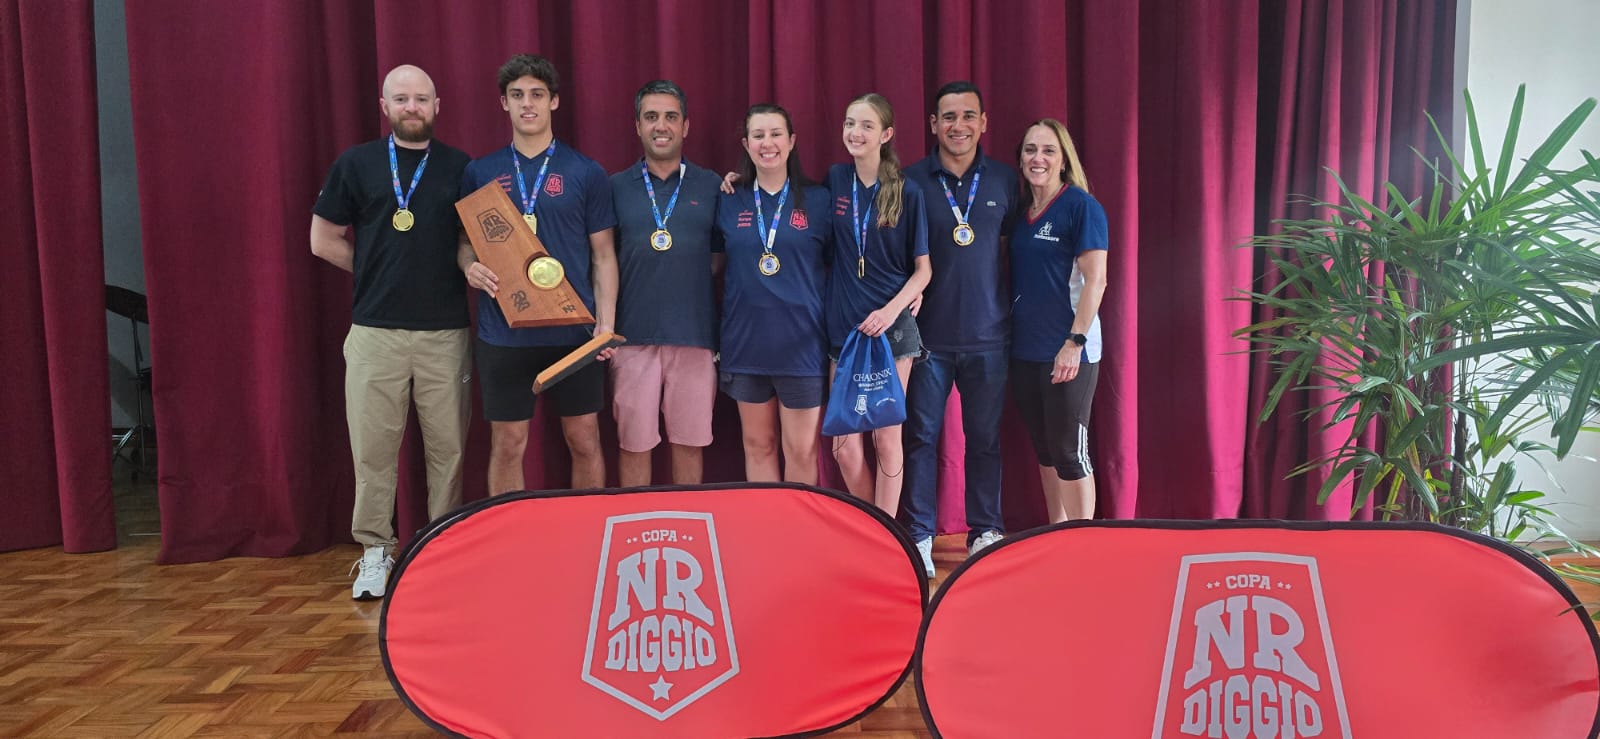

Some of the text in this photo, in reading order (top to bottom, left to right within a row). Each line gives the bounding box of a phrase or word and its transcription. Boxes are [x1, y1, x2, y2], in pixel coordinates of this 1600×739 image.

[483, 215, 506, 233] NR
[641, 529, 678, 543] COPA
[608, 547, 715, 631] NR
[1225, 574, 1271, 590] COPA
[604, 614, 717, 673] DIGGIO
[1183, 595, 1321, 692] NR
[1180, 674, 1323, 739] DIGGIO
